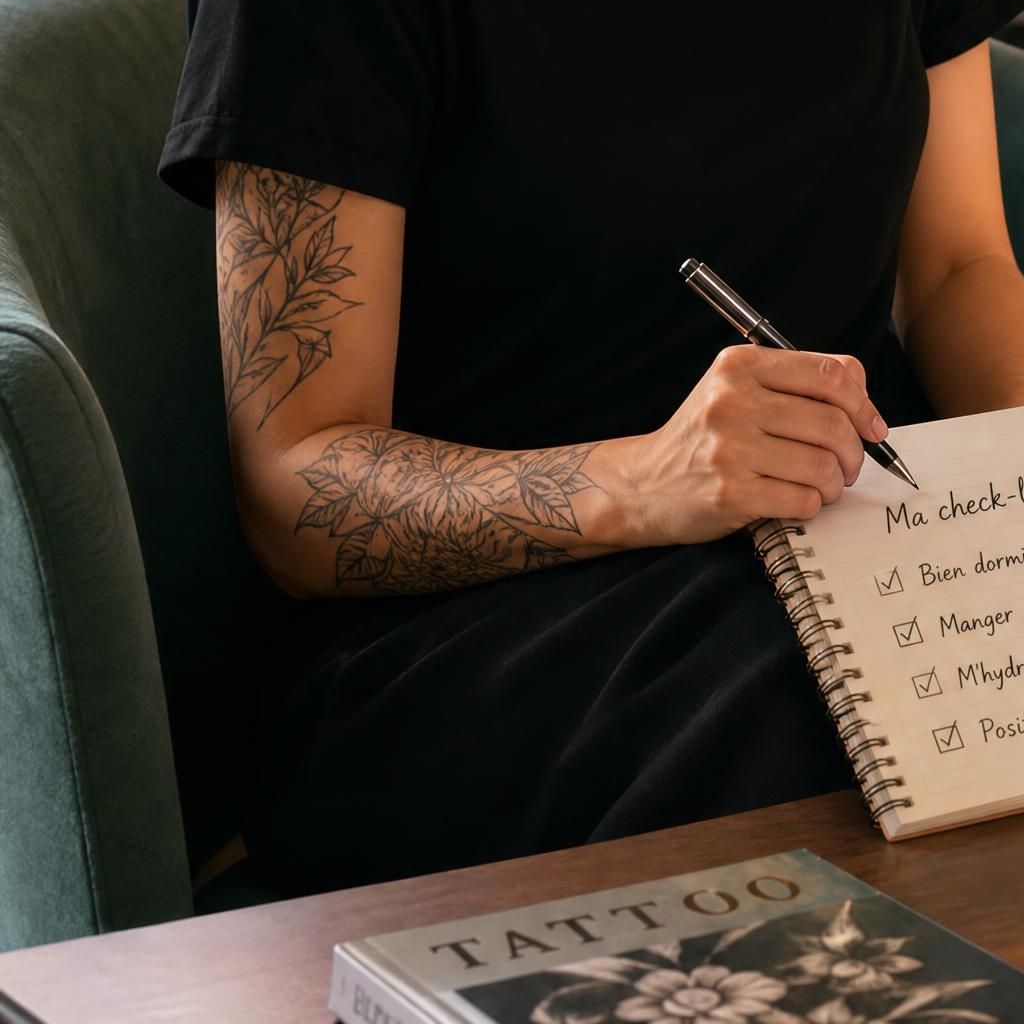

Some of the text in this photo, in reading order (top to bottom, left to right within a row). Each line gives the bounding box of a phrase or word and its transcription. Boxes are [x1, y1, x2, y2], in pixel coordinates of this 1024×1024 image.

[885, 501, 929, 535] Ma
[918, 562, 967, 587] Bien
[939, 605, 1014, 638] Manger
[429, 874, 802, 971] TATTOO
